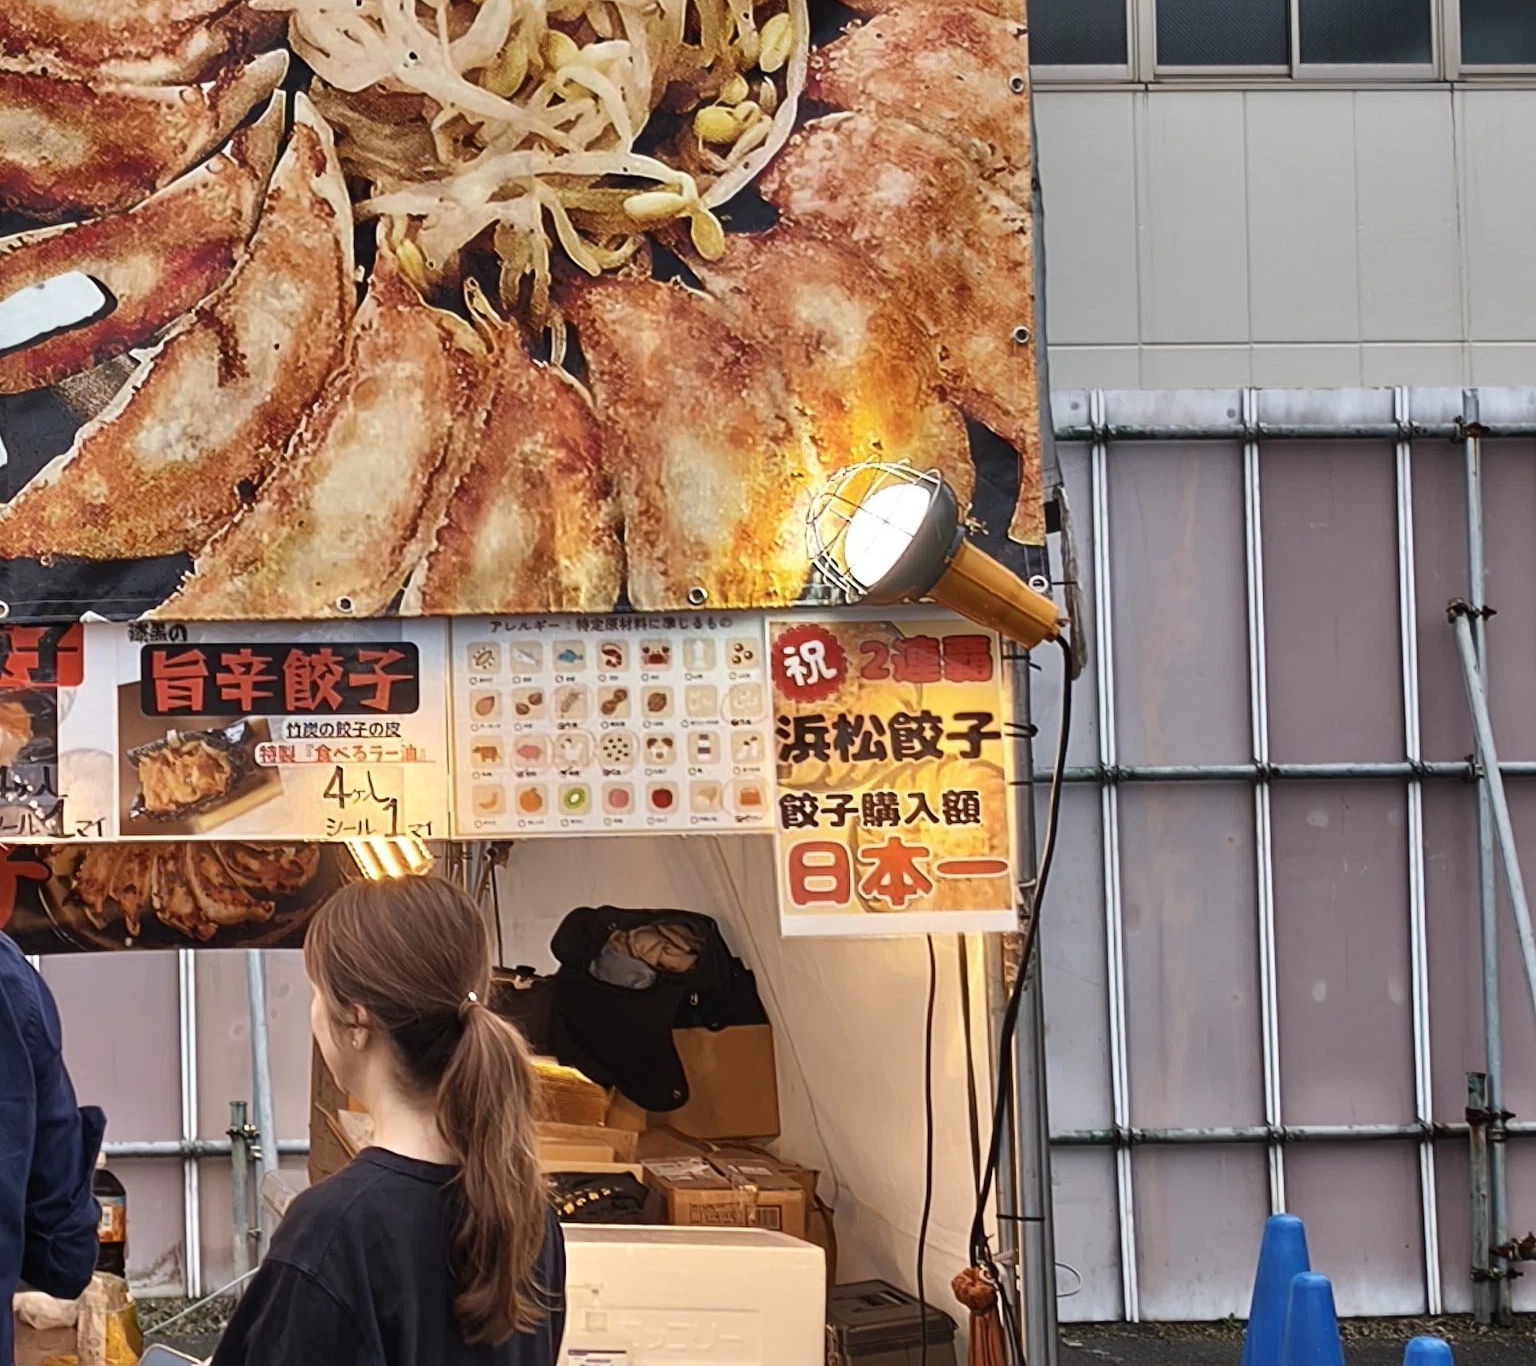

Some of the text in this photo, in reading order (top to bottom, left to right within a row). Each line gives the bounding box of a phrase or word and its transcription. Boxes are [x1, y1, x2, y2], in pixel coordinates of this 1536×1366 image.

[151, 647, 414, 713] 旨辛餃子
[782, 639, 838, 687] 祝
[860, 635, 993, 683] 2連覇
[776, 710, 1002, 764] 浜松餃子
[779, 790, 981, 829] 餃子購入額
[788, 836, 1010, 907] 日本一
